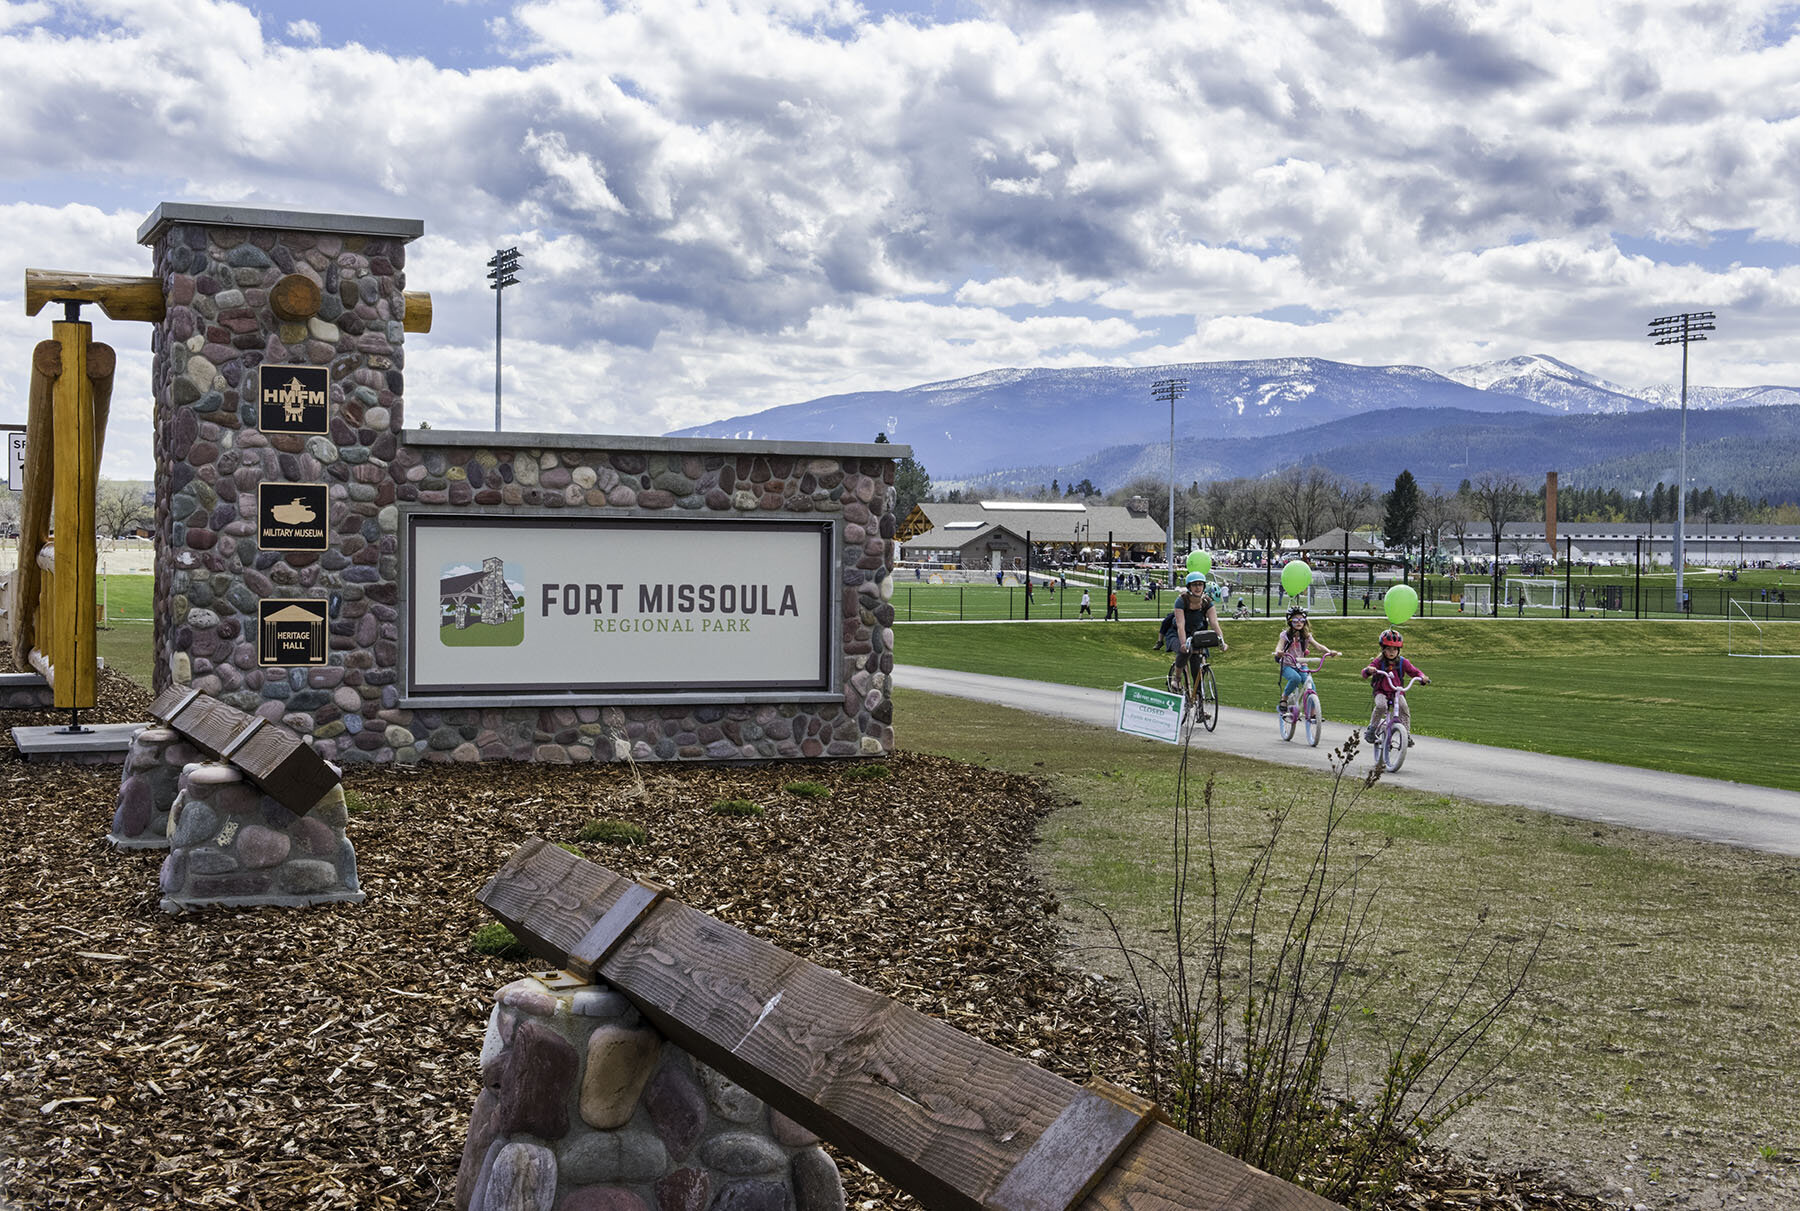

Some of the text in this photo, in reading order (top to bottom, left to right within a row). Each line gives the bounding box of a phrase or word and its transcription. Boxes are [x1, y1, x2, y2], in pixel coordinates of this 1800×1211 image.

[263, 388, 325, 405] HMFM
[262, 528, 324, 538] MILITARY MUSEUM
[541, 583, 799, 617] FORT MISSOULA
[593, 618, 751, 633] REGIONAL PARK
[277, 631, 310, 640] HERITAGE
[283, 642, 305, 650] HALL
[1139, 704, 1165, 716] CLOSED
